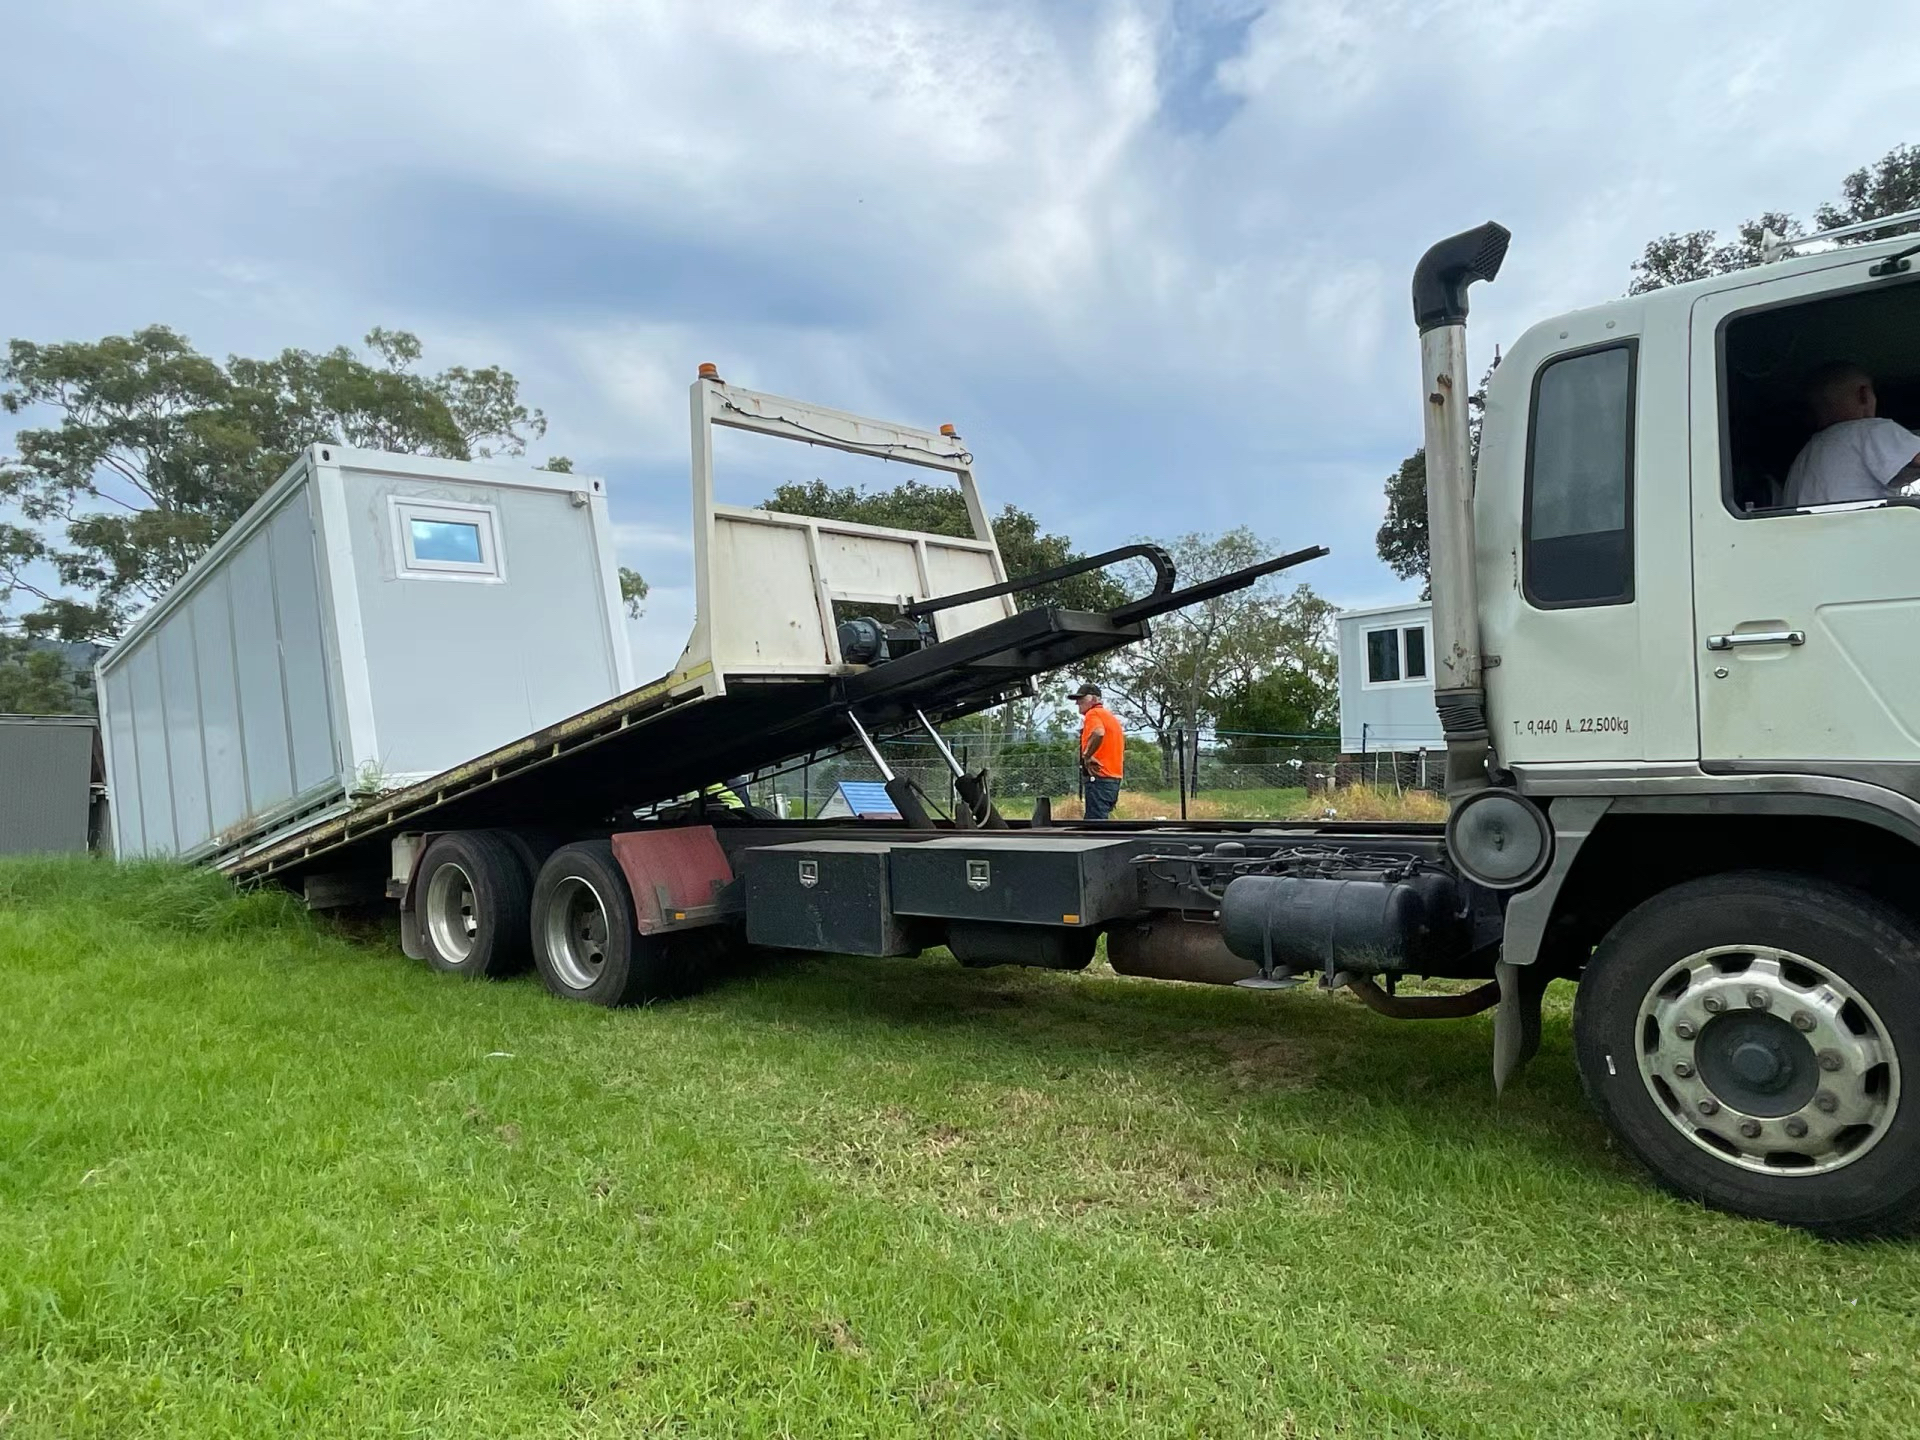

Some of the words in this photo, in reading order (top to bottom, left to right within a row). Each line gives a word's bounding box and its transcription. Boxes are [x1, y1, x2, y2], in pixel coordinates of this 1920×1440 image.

[1513, 720, 1523, 735] T.
[1527, 719, 1558, 736] 9,940
[1580, 716, 1629, 735] 22,500kg
